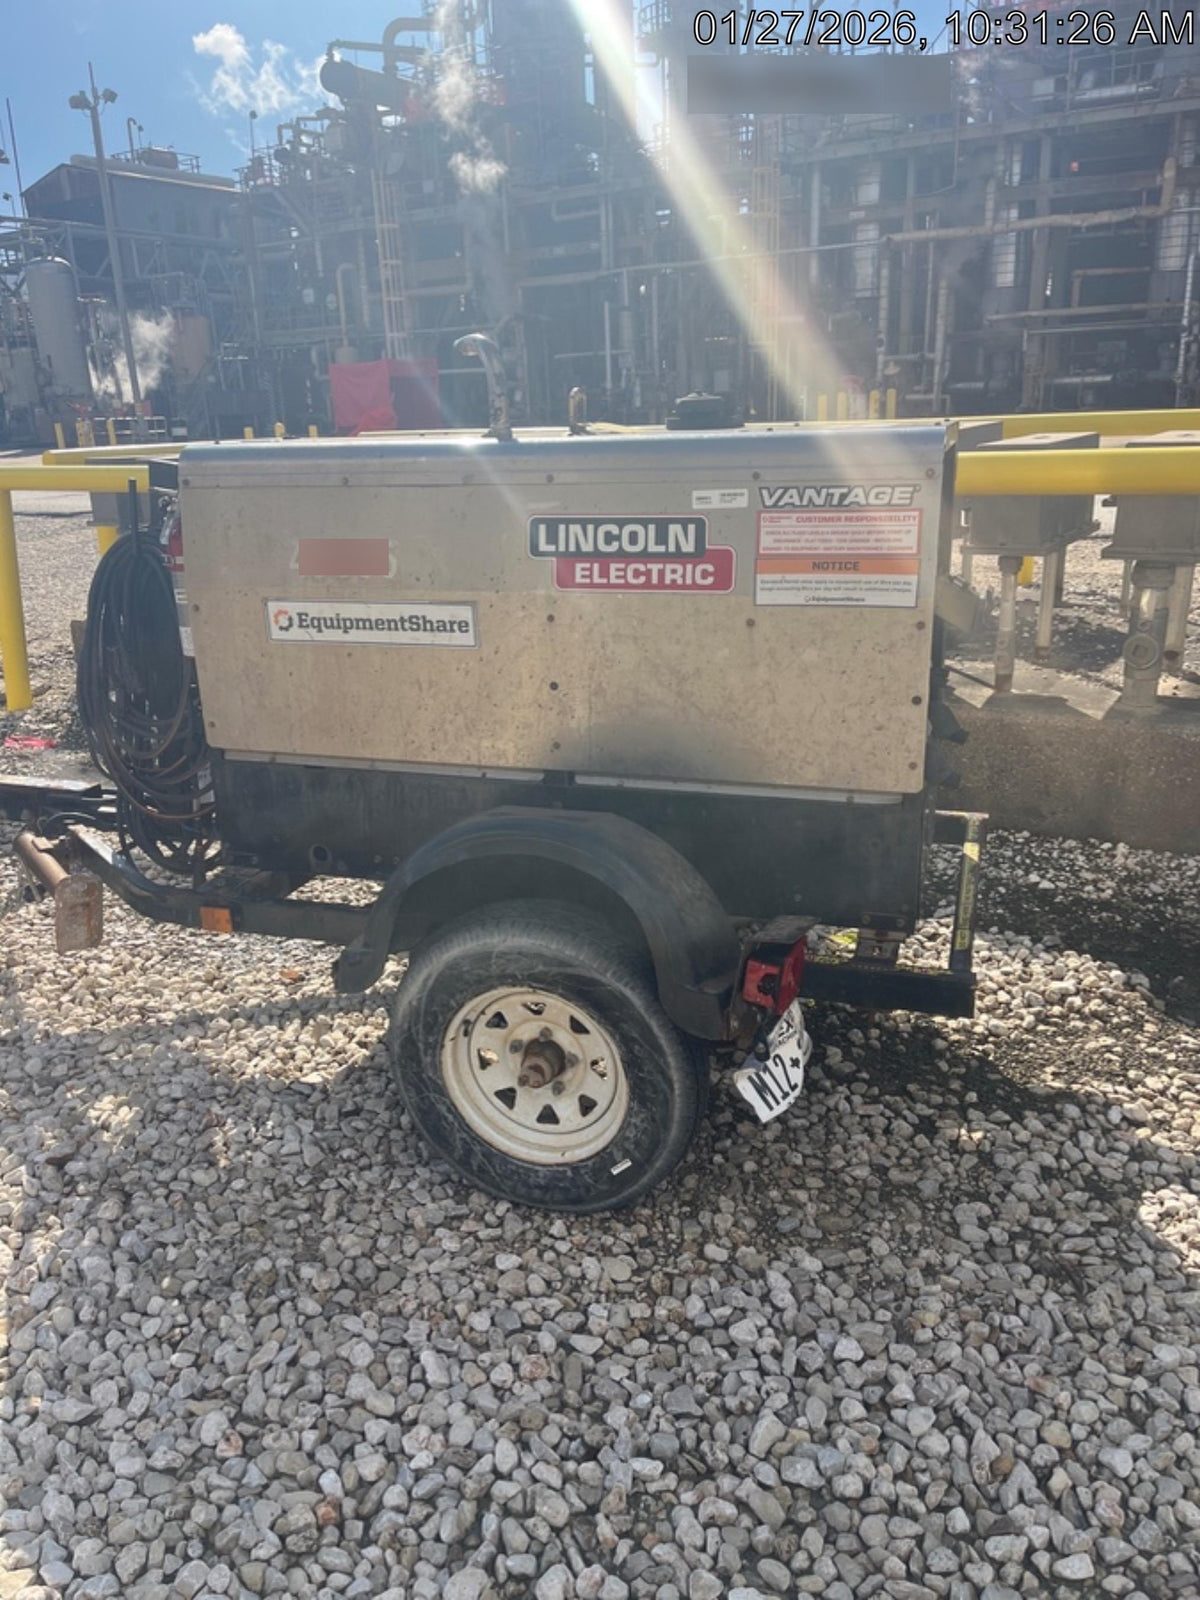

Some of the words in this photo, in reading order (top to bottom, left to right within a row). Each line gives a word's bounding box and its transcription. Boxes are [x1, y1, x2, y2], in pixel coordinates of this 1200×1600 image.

[759, 485, 916, 508] VANTAGE
[795, 514, 843, 524] CUSTOMER
[844, 514, 918, 523] RESPONSIBILITY
[538, 523, 696, 553] LINCOLN
[574, 562, 715, 585] ELECTRIC
[811, 561, 861, 571] NOTICE
[296, 611, 470, 634] EquipmentShare
